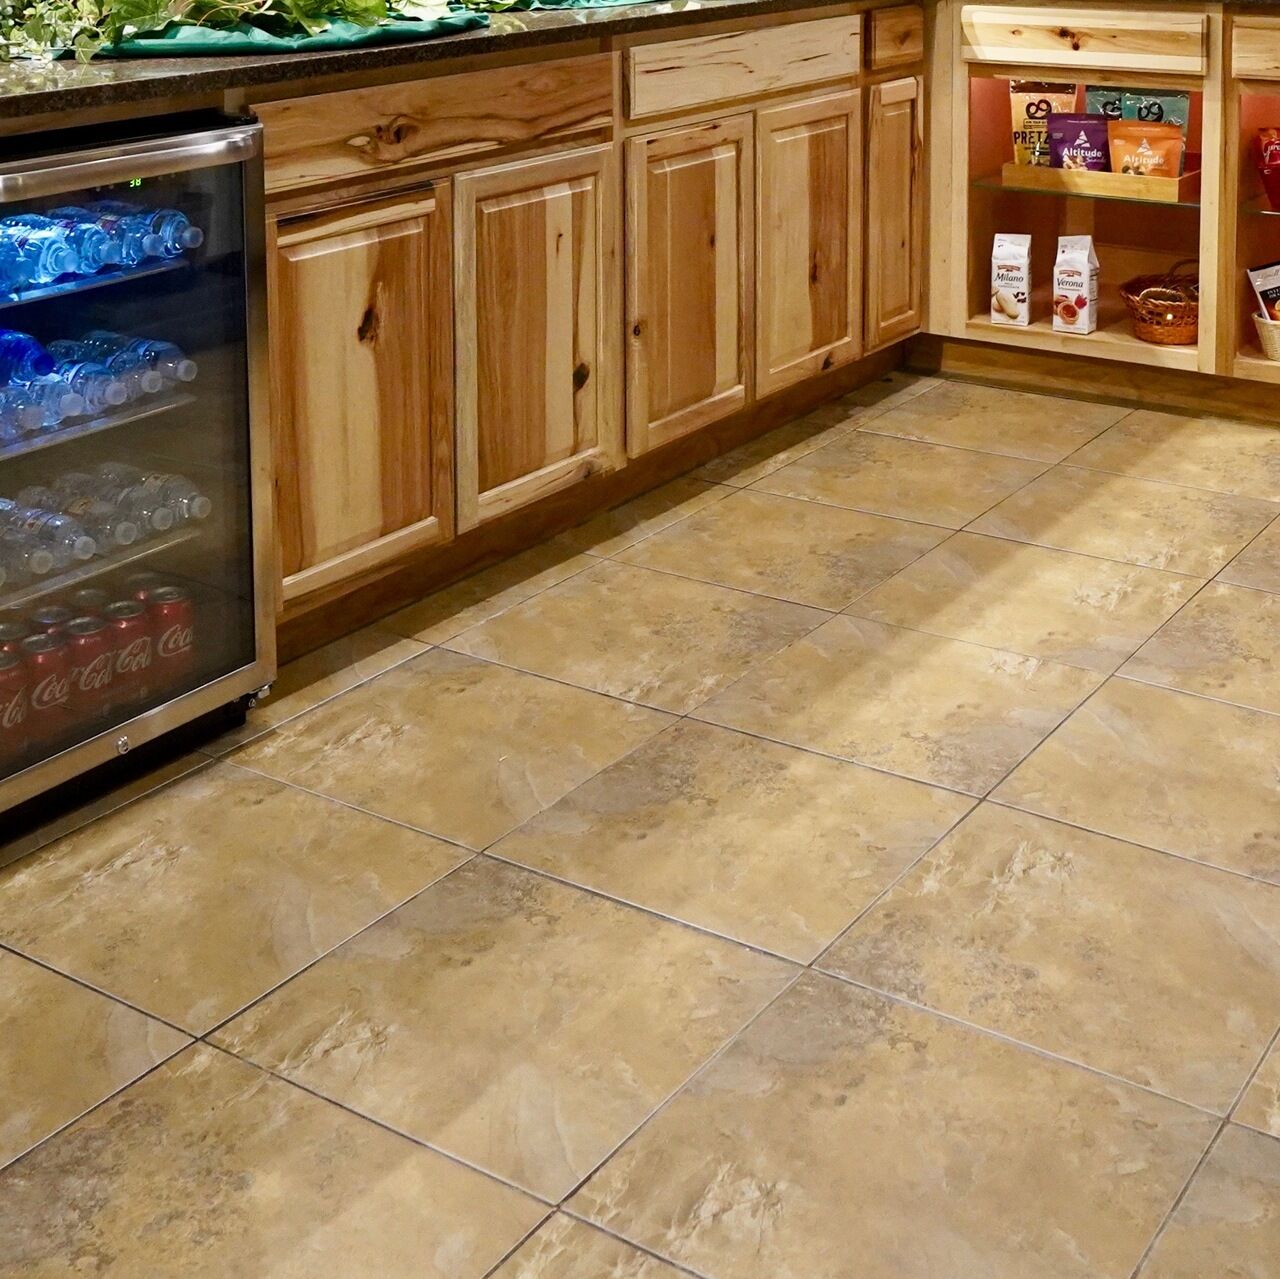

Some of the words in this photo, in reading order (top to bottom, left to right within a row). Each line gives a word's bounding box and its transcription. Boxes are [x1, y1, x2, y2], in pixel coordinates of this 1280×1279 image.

[1013, 130, 1049, 145] PRETZ
[1062, 147, 1103, 158] Altitude
[994, 272, 1024, 283] Milano
[1056, 277, 1084, 288] Verona
